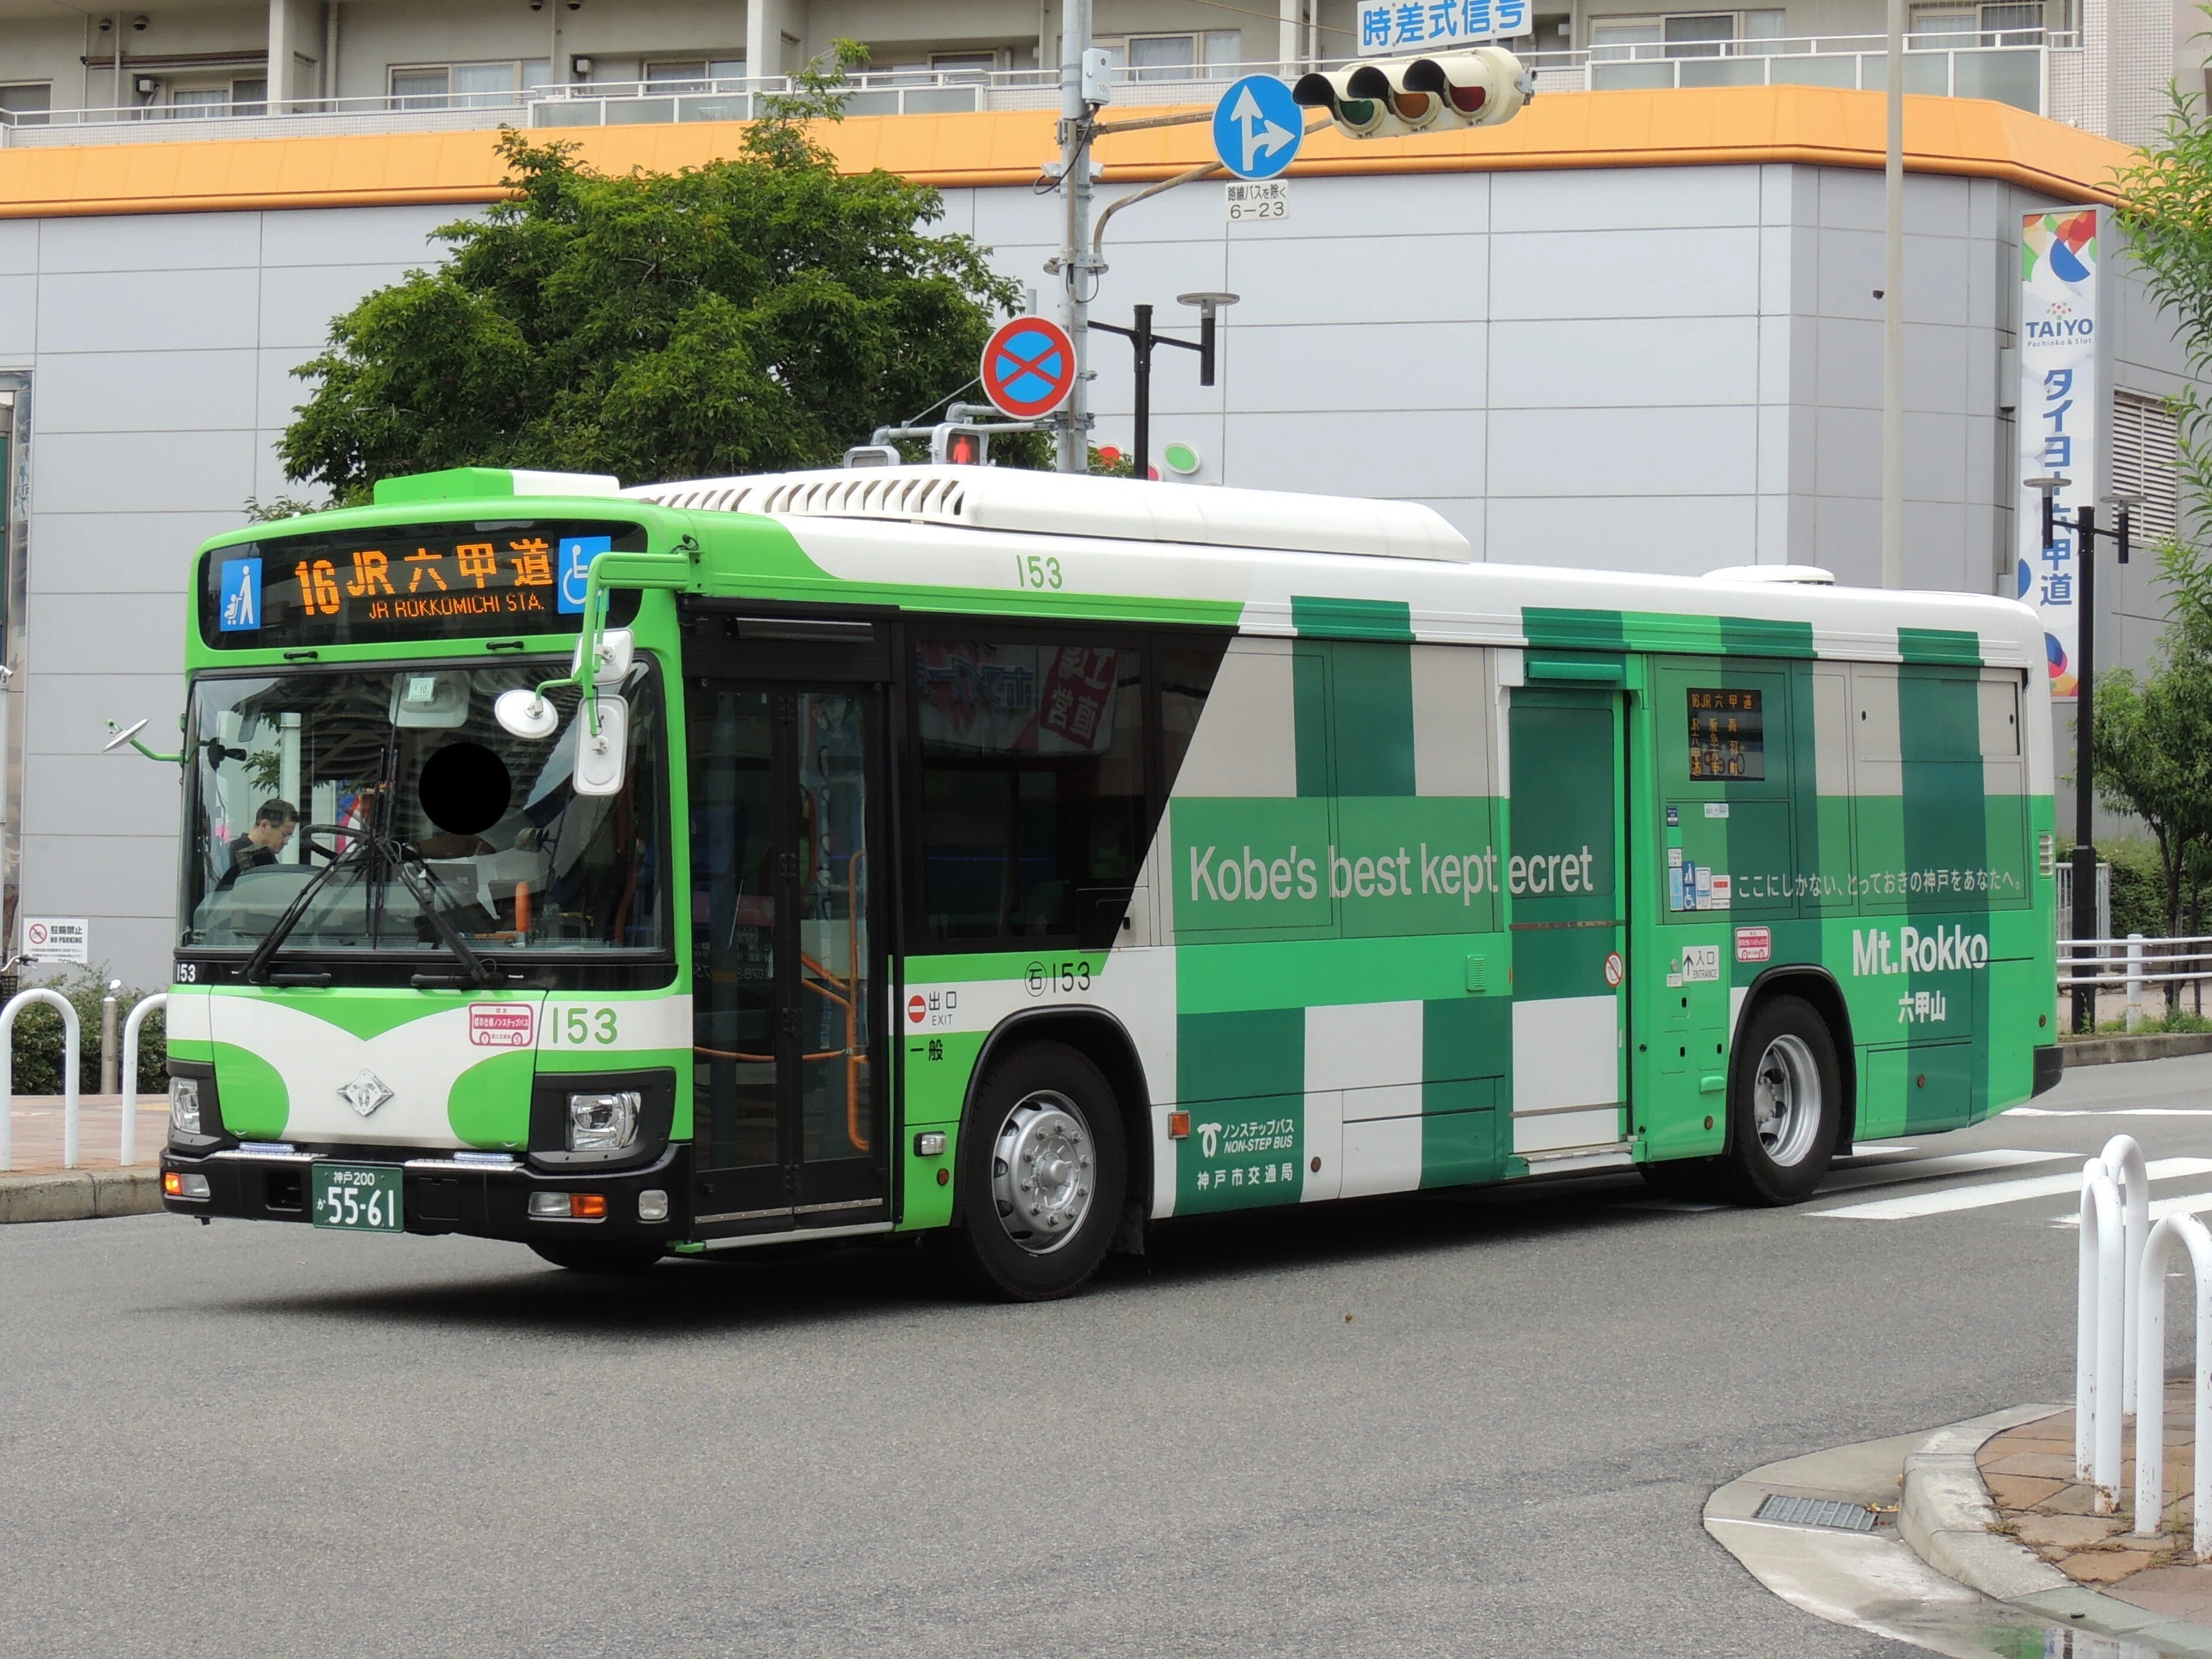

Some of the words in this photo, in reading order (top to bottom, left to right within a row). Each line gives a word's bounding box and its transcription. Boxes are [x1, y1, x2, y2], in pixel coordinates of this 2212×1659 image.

[1363, 0, 1525, 47] 時差式信号
[1228, 184, 1286, 202] 路線バスを除く
[295, 560, 340, 615] 16
[345, 538, 553, 596] JR六甲道
[1016, 554, 1063, 589] 153
[369, 600, 389, 619] JR
[506, 592, 544, 611] STA.
[1692, 693, 1700, 708] 16
[1190, 845, 1317, 902] Kobe's
[1330, 845, 1412, 898] best
[1420, 843, 1499, 906] kept
[1508, 845, 1594, 892] ecret
[1738, 869, 2020, 899] ここにしかない、とっておきの神戸をあなたへ。
[50, 925, 83, 935] 駐輪禁止
[1696, 950, 1714, 966] 入口
[177, 964, 196, 982] 153
[1052, 961, 1091, 993] 153
[1693, 969, 1717, 979] ENTRANCE
[928, 990, 957, 1011] 出口
[1898, 991, 1946, 1023] 六甲山
[553, 1007, 618, 1045] 153
[932, 1014, 953, 1026] EXIT
[910, 1039, 943, 1061] 一般
[1223, 1118, 1294, 1139] ノンステップバス
[1224, 1138, 1271, 1154] NON-STEP
[1273, 1137, 1293, 1149] BUS
[1197, 1162, 1294, 1191] 神戸市交通局
[317, 1198, 325, 1211] か
[328, 1187, 395, 1227] 55-61
